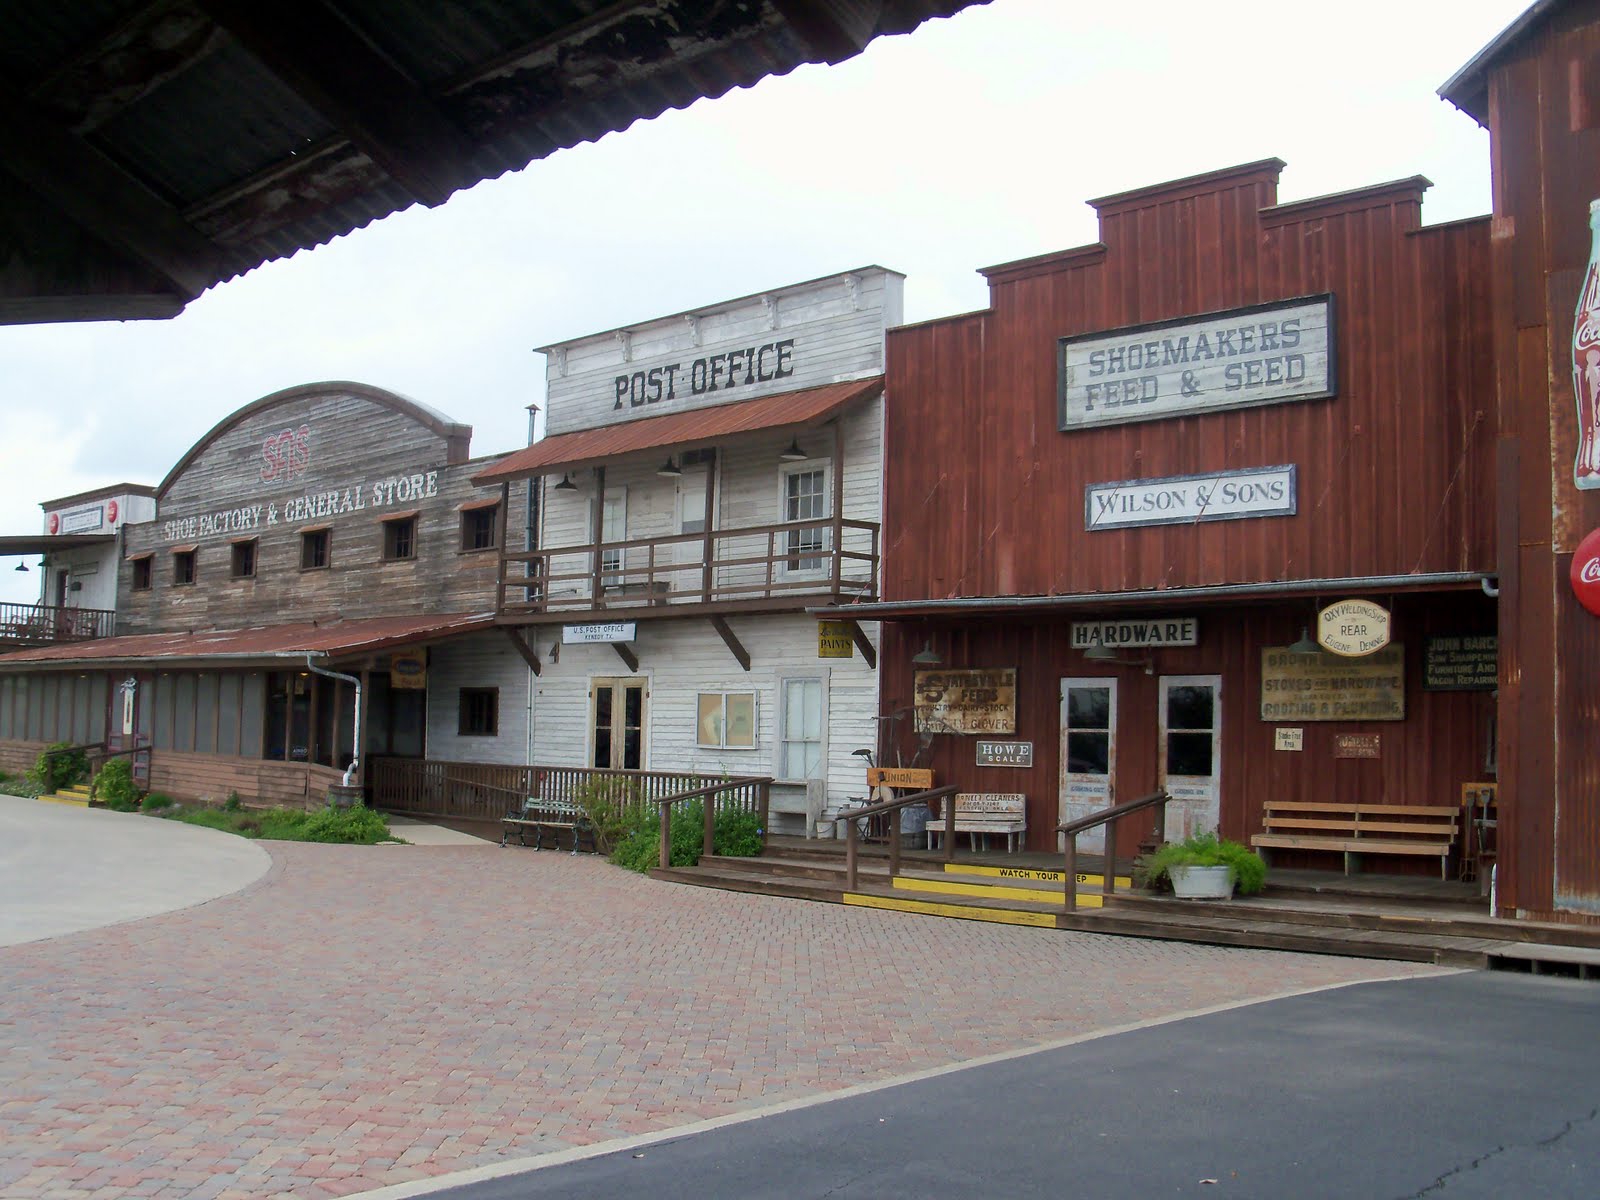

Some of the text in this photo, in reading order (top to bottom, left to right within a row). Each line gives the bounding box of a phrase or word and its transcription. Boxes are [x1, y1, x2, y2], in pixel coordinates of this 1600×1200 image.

[1089, 319, 1301, 377] SHOEMAKERS
[614, 339, 795, 410] POST OFFICE
[1085, 354, 1306, 411] FEED & SEED
[1096, 480, 1285, 514] WILSON & SONS
[164, 471, 438, 540] SHOE FACTORY & GENERAL STORE
[1324, 607, 1340, 622] OXY
[1075, 623, 1193, 644] HARDWARE
[1341, 625, 1367, 636] REAR
[820, 639, 851, 649] PAINTS
[1324, 634, 1351, 652] EUGENE
[1450, 652, 1498, 663] SHARPENIN
[1476, 663, 1496, 673] AND
[1265, 678, 1312, 691] STOVES
[1263, 702, 1316, 715] ROOFING
[982, 744, 1029, 756] HOWE
[884, 772, 912, 784] UNION
[986, 794, 1020, 802] CLEANERS
[1000, 868, 1030, 878] WATCH
[1035, 871, 1059, 881] YOUR
